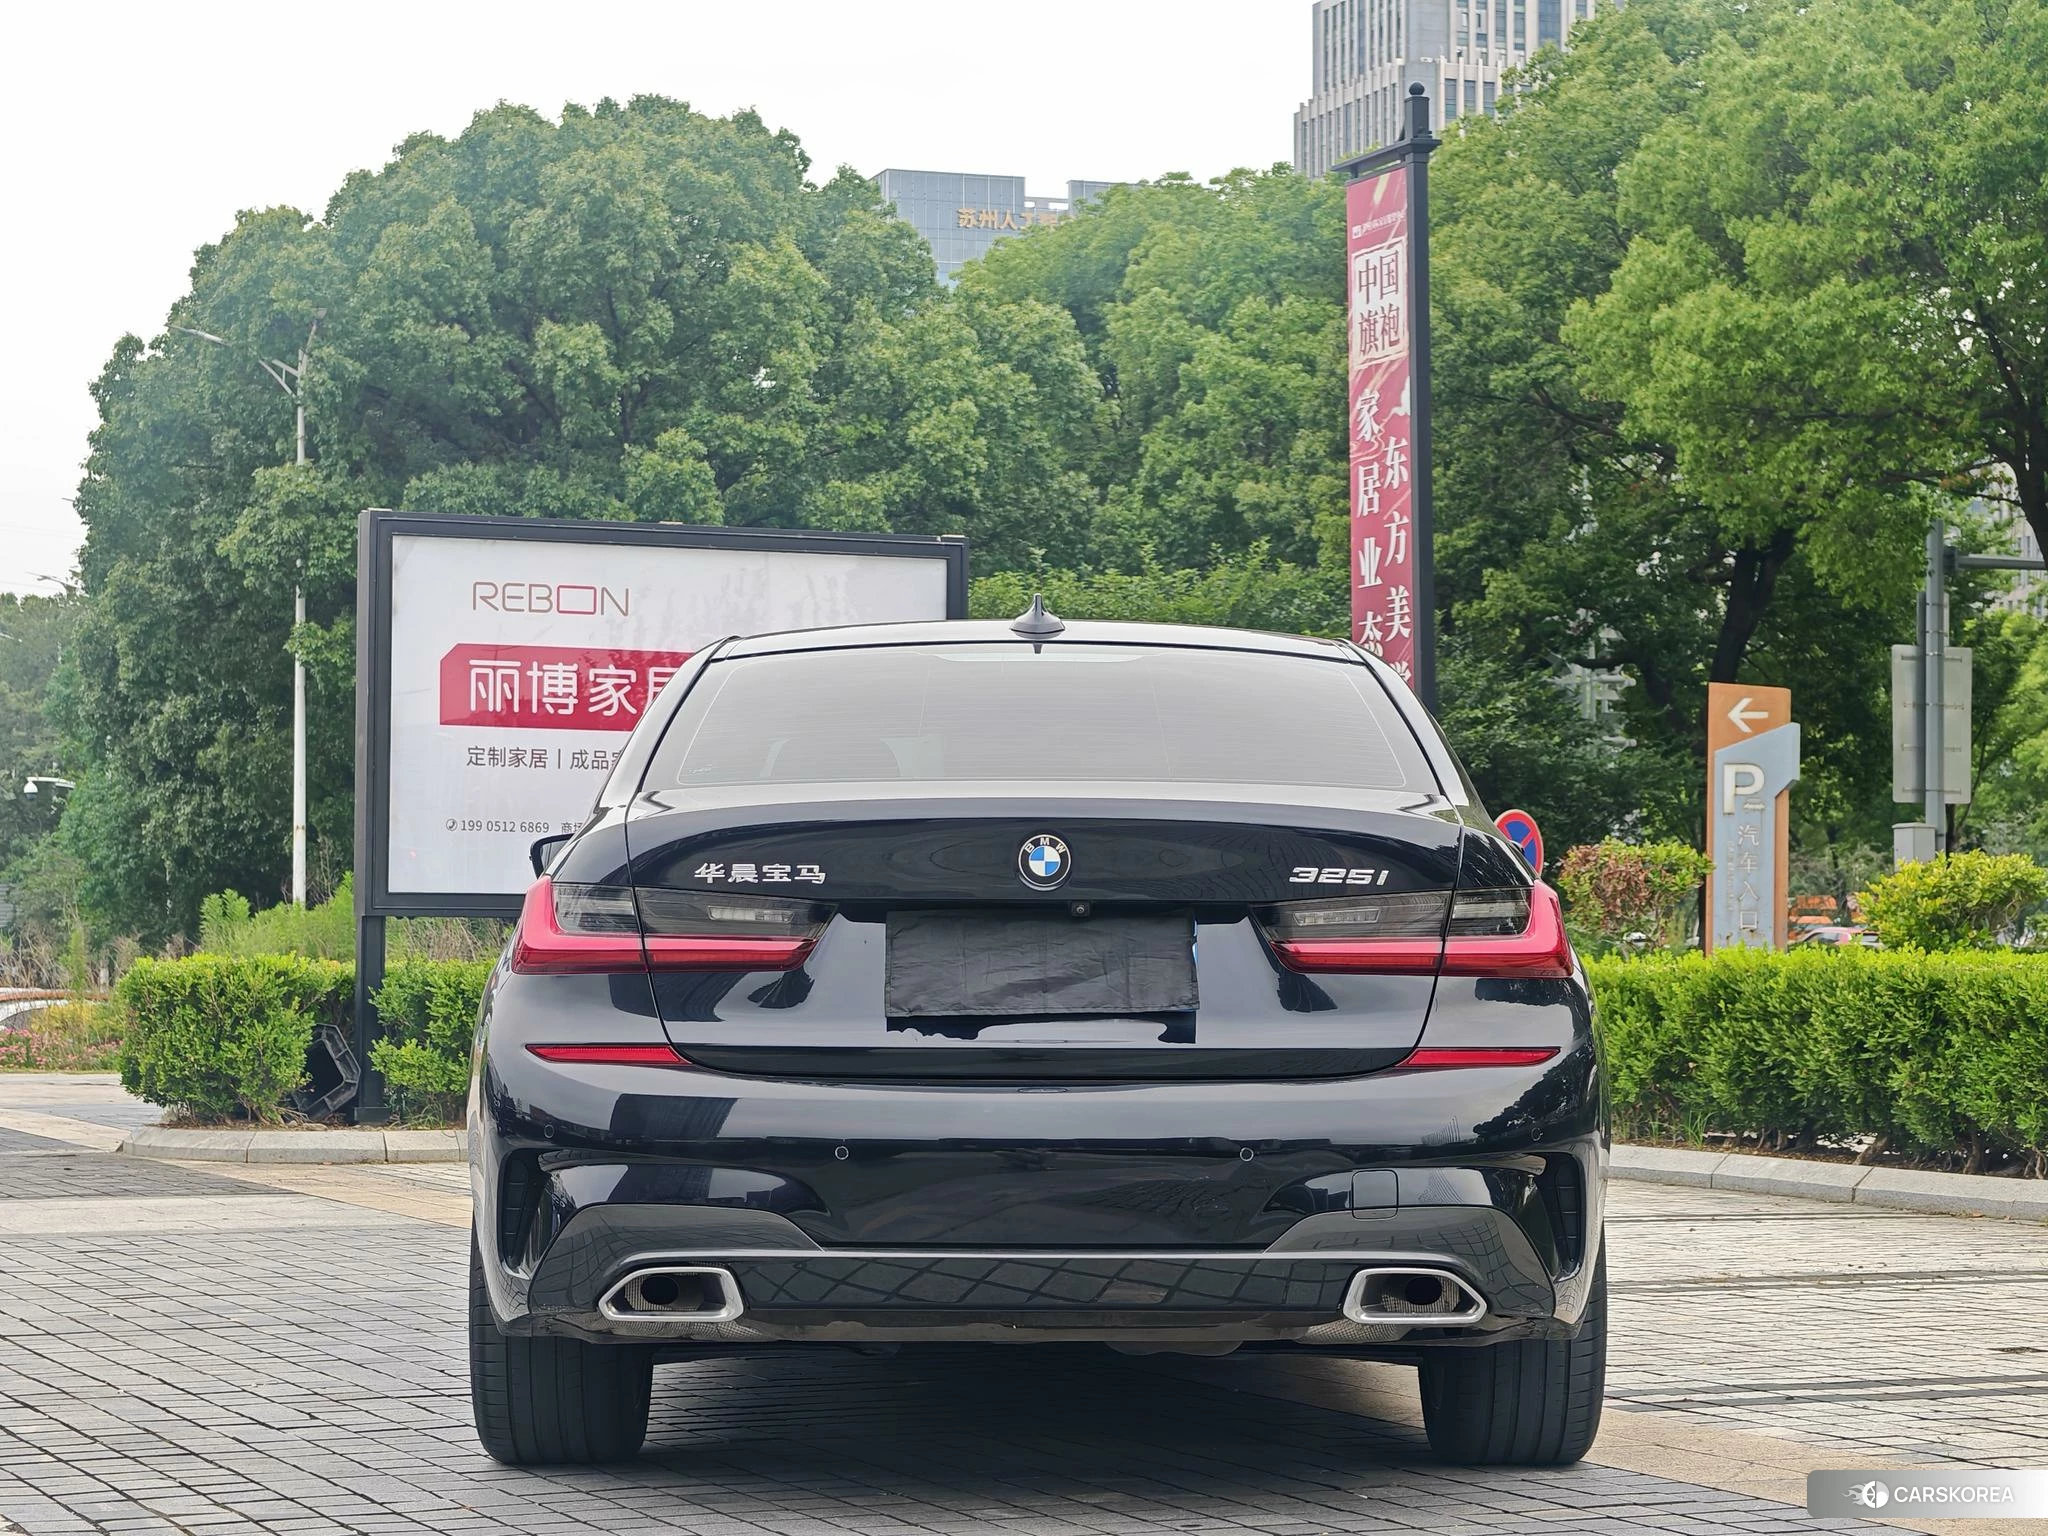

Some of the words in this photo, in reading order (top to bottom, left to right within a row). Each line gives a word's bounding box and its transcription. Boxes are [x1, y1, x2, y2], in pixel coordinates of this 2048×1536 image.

[1358, 251, 1399, 304] 中国
[1358, 303, 1401, 356] 旗袍
[472, 581, 629, 617] REBON
[466, 746, 549, 769] 定制家居
[1722, 763, 1765, 815] P
[460, 820, 483, 832] 199
[486, 820, 516, 833] 0512
[519, 821, 550, 833] 6869
[1024, 837, 1067, 854] BMW
[694, 862, 826, 885] 华晨宝马
[1737, 824, 1760, 932] 汽车入口
